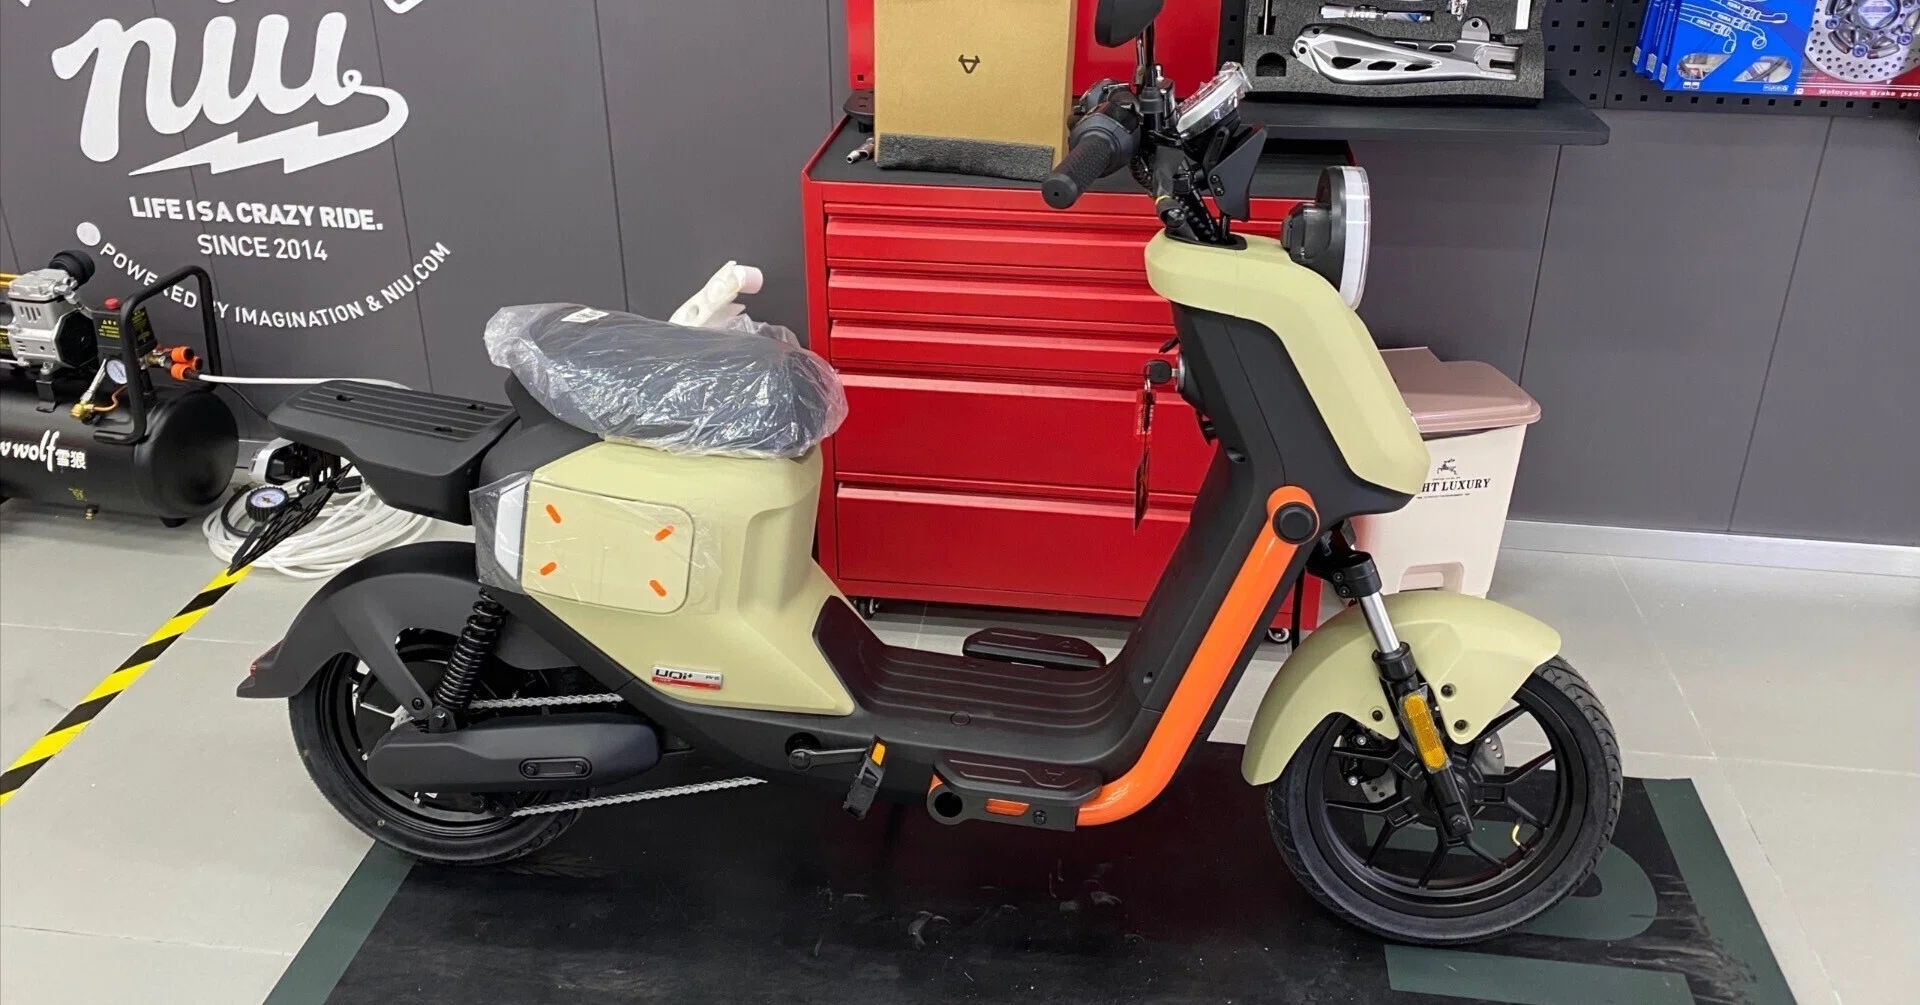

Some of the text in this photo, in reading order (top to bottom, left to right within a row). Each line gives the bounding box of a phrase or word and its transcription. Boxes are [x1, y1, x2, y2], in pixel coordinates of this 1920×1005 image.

[1870, 89, 1896, 97] Brake
[129, 196, 183, 220] LIFE
[236, 202, 314, 227] CRAZY
[320, 206, 383, 231] RIDE.
[197, 233, 328, 261] SINCE 2014
[100, 242, 198, 309] POWEED
[235, 301, 364, 328] IMAGINATION
[366, 295, 383, 312] &
[380, 241, 451, 304] NIU.COM
[1441, 478, 1491, 492] LUXURY
